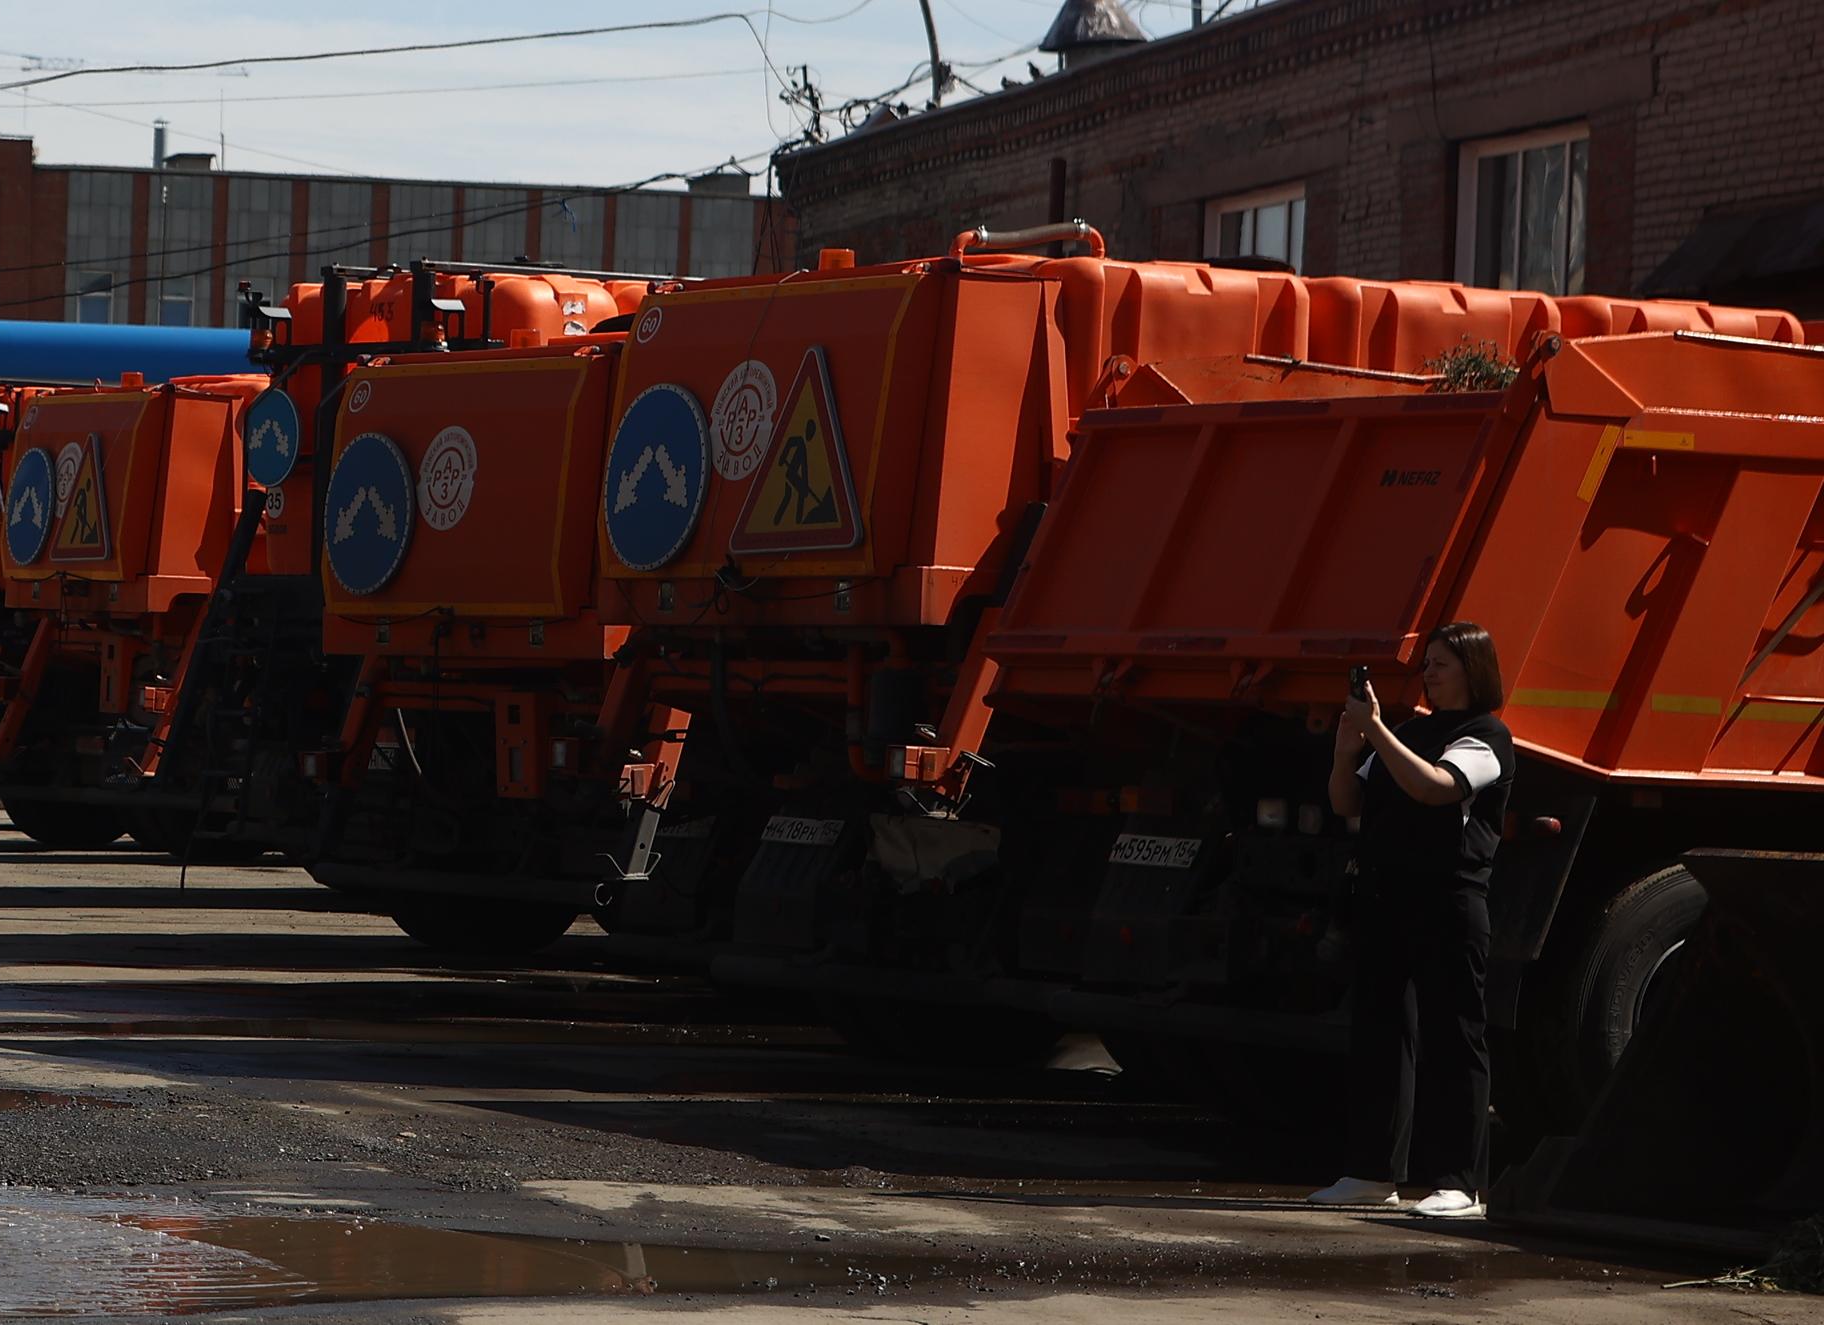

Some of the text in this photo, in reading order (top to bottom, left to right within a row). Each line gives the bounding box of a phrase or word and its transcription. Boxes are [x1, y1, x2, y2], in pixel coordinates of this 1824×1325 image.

[642, 317, 657, 333] 60
[353, 389, 367, 404] 60
[1398, 471, 1442, 486] NEFAZ
[268, 492, 282, 510] 35
[424, 498, 465, 526] ЗАВОД
